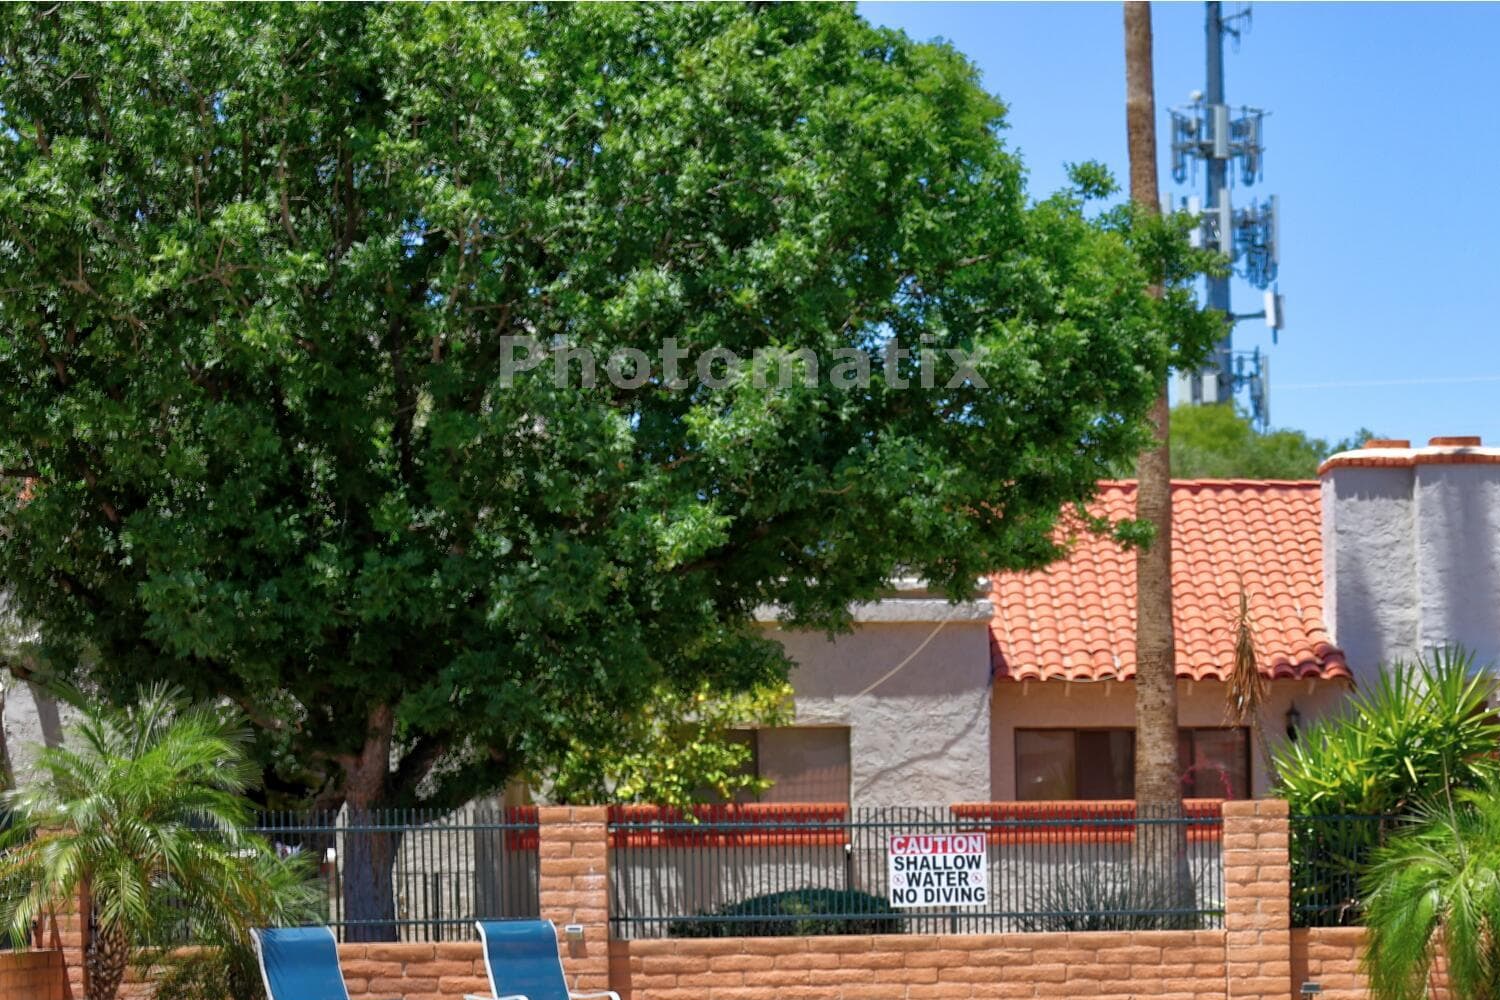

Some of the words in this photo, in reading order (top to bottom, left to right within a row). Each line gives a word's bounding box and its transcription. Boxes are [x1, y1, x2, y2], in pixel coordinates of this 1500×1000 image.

[892, 836, 984, 854] CAUTION
[894, 855, 982, 871] SHALLOW
[906, 871, 969, 887] WATER
[893, 888, 917, 904] NO
[924, 887, 985, 903] DIVING
